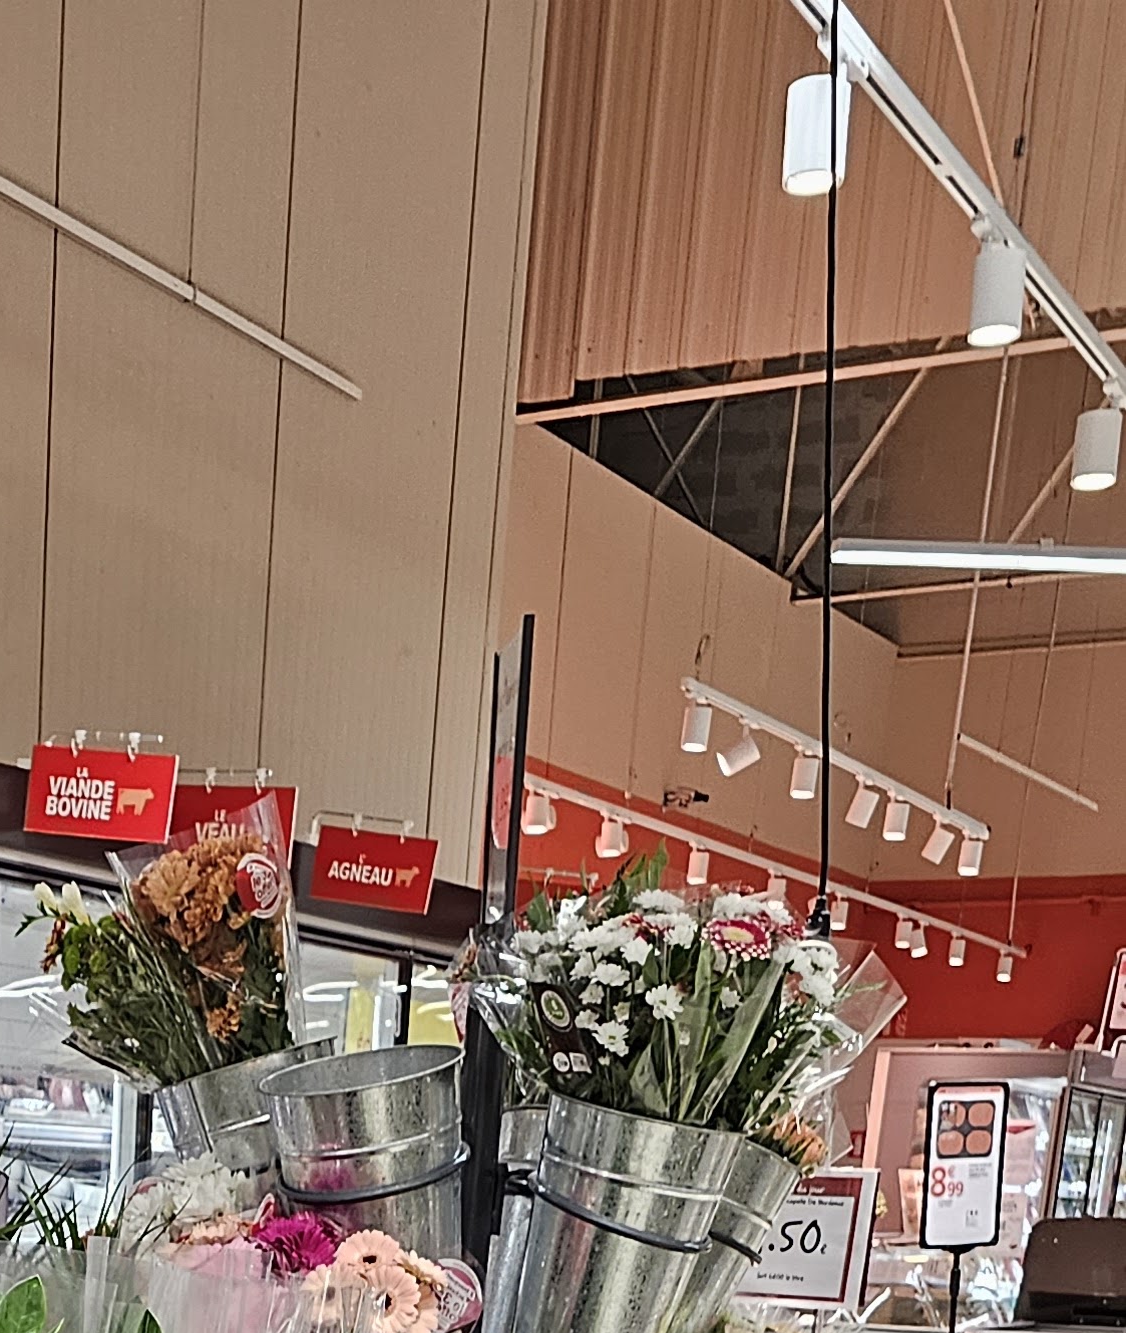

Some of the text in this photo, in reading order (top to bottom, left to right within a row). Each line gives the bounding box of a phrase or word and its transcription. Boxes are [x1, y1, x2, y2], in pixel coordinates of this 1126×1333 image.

[76, 766, 89, 778] LA
[49, 776, 115, 800] VIANDE
[45, 795, 112, 821] BOVINE
[214, 809, 226, 822] LE
[328, 860, 394, 887] AGNEAU
